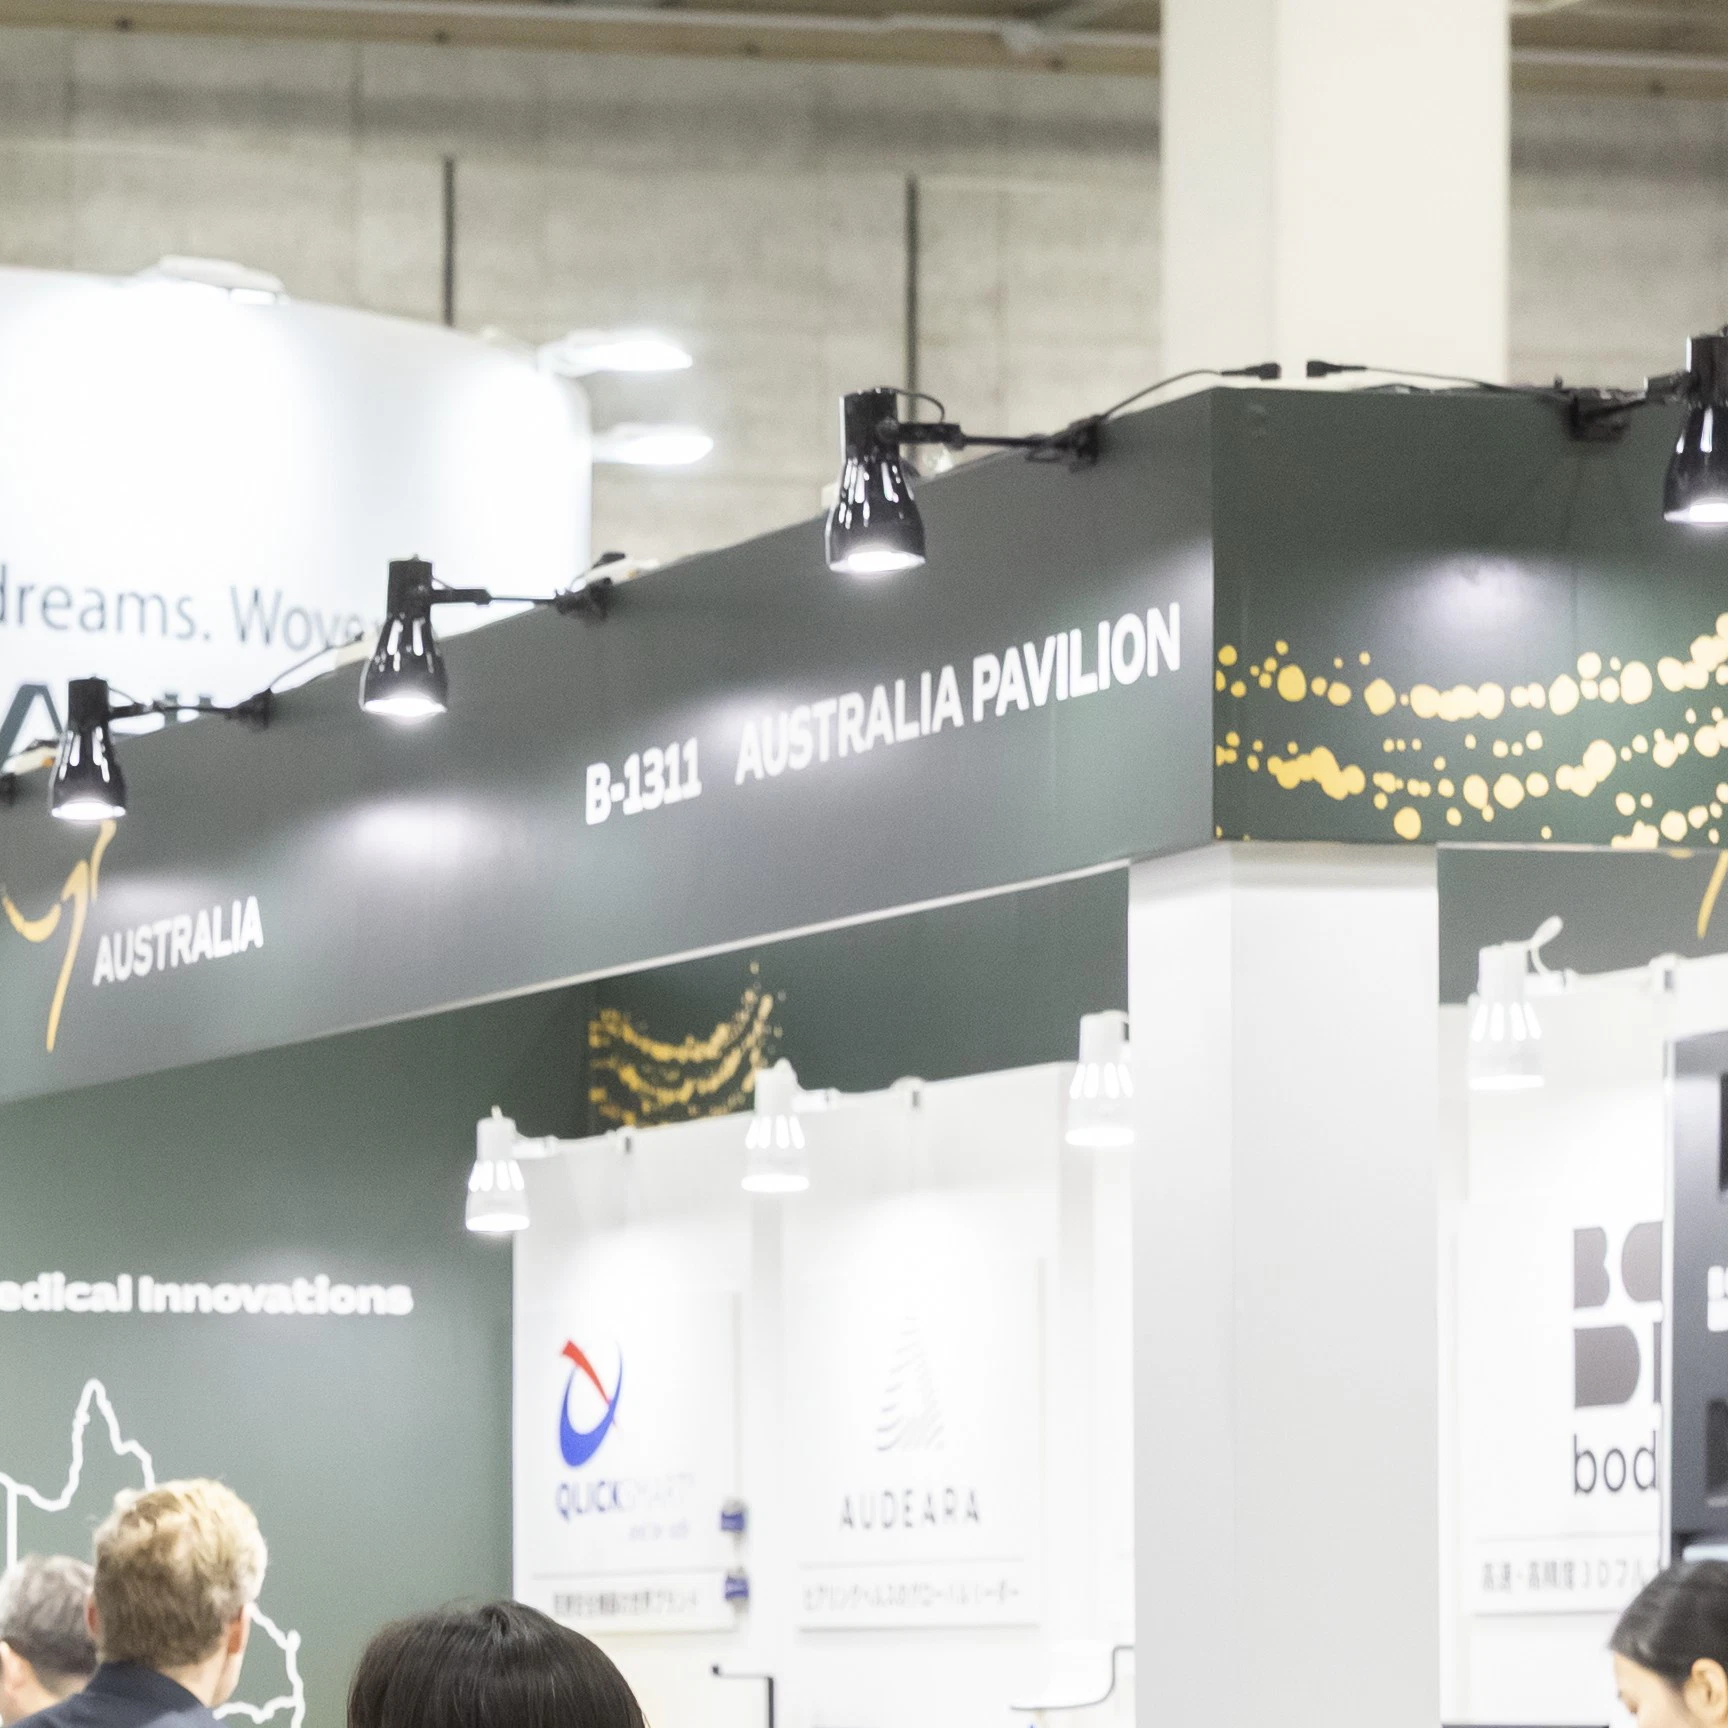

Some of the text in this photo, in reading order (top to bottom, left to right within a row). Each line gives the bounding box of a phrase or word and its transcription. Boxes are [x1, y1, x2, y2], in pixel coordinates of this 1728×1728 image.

[230, 584, 382, 652] Wove
[585, 601, 1180, 826] B-1311 AUSTRALIA PAVILION
[92, 895, 264, 988] AUSTRALIA
[138, 1274, 415, 1317] Innovations
[839, 1486, 982, 1531] AUDEARA
